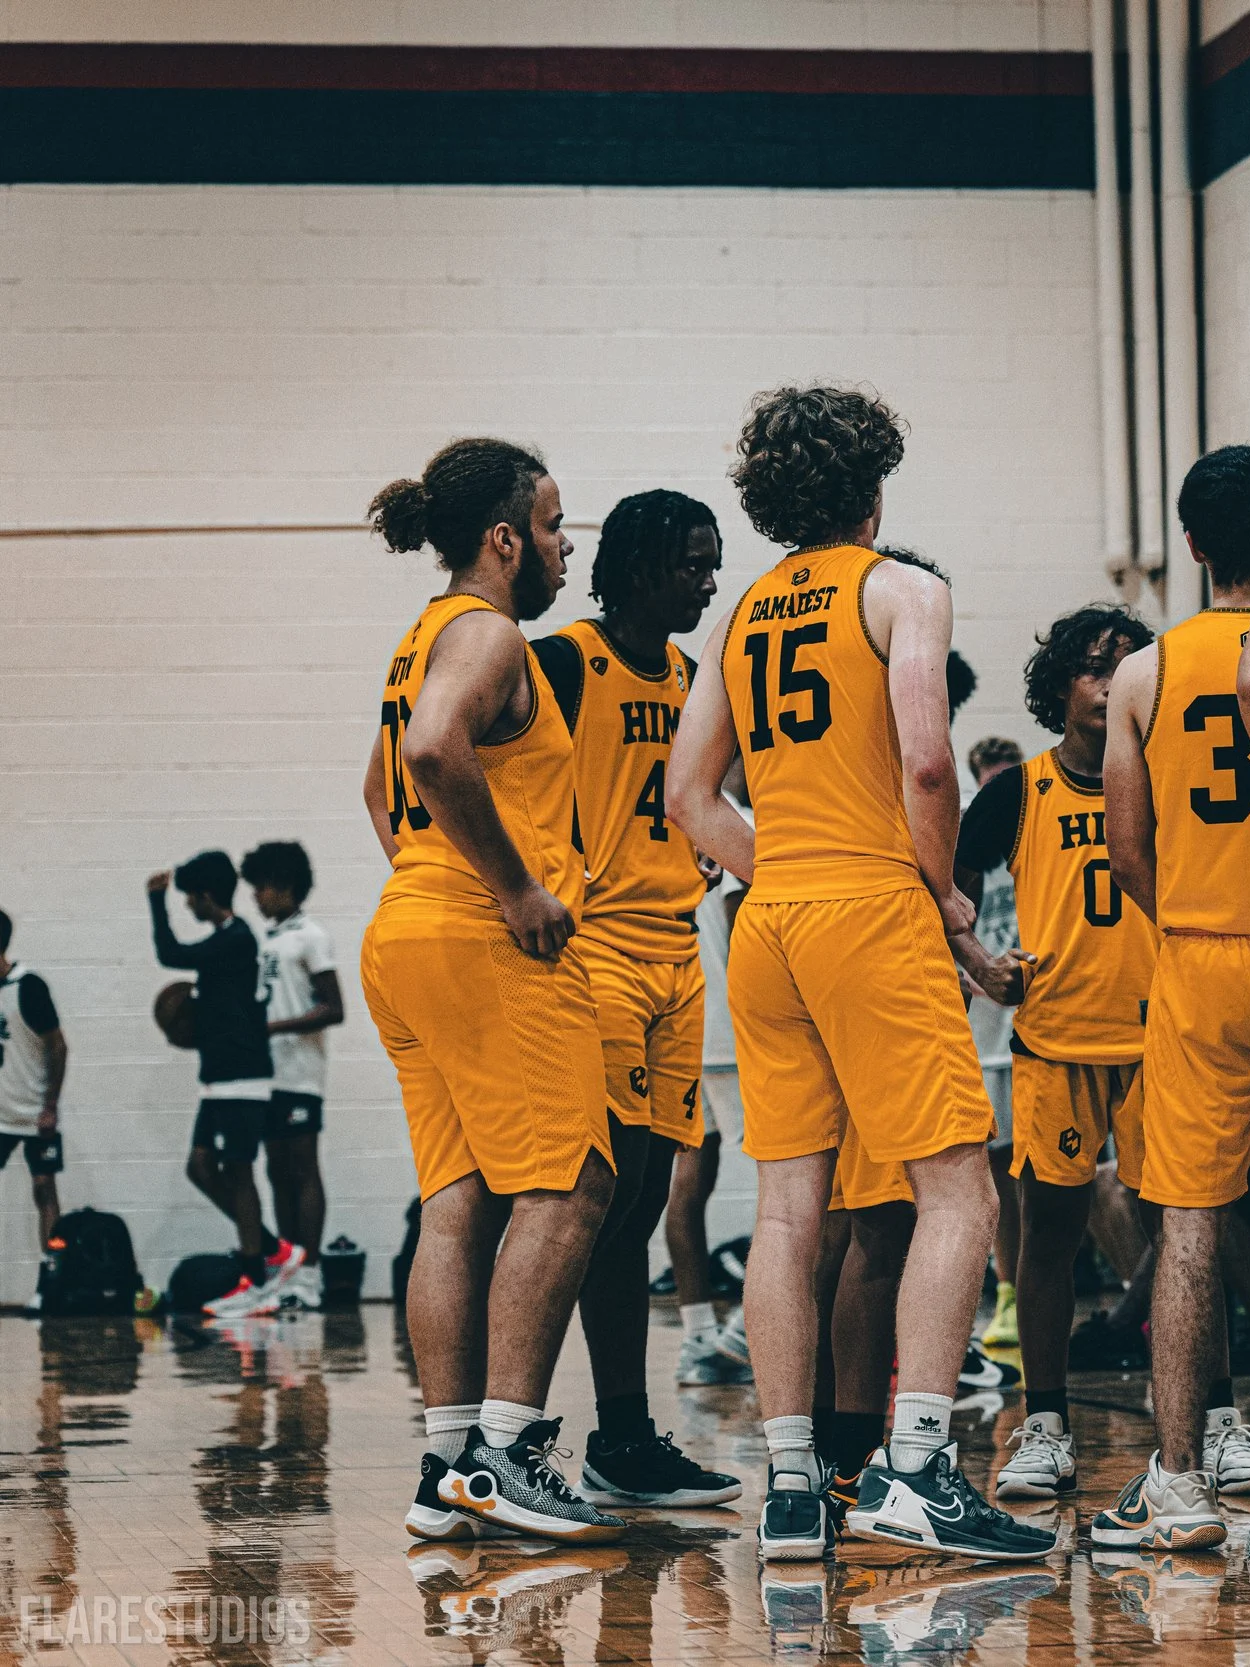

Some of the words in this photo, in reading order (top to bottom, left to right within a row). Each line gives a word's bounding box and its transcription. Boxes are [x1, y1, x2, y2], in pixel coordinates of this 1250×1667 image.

[744, 622, 832, 752] 15
[620, 701, 681, 745] HIM
[635, 760, 668, 842] 4
[1058, 812, 1107, 850] HI
[1083, 859, 1122, 928] 0
[683, 1077, 699, 1120] 4
